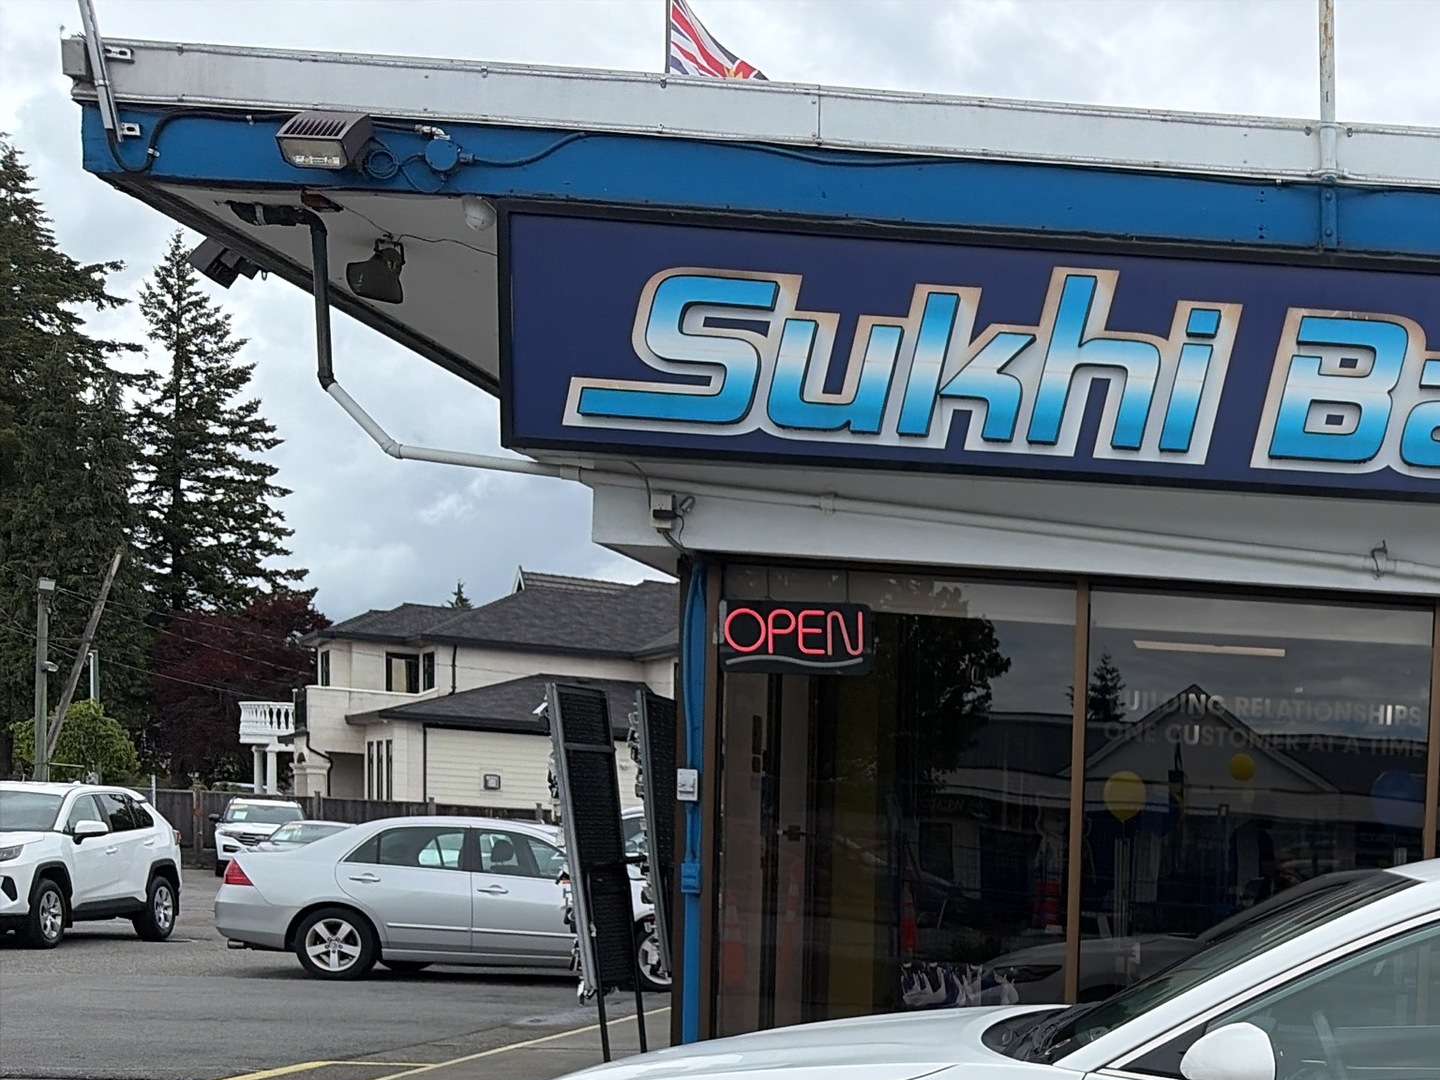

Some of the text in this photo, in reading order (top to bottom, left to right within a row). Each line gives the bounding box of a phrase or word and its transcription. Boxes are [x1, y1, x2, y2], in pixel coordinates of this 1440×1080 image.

[563, 266, 1242, 464] Sukhi
[724, 608, 864, 656] OPEN
[1235, 697, 1422, 727] RELATIONSHIPS
